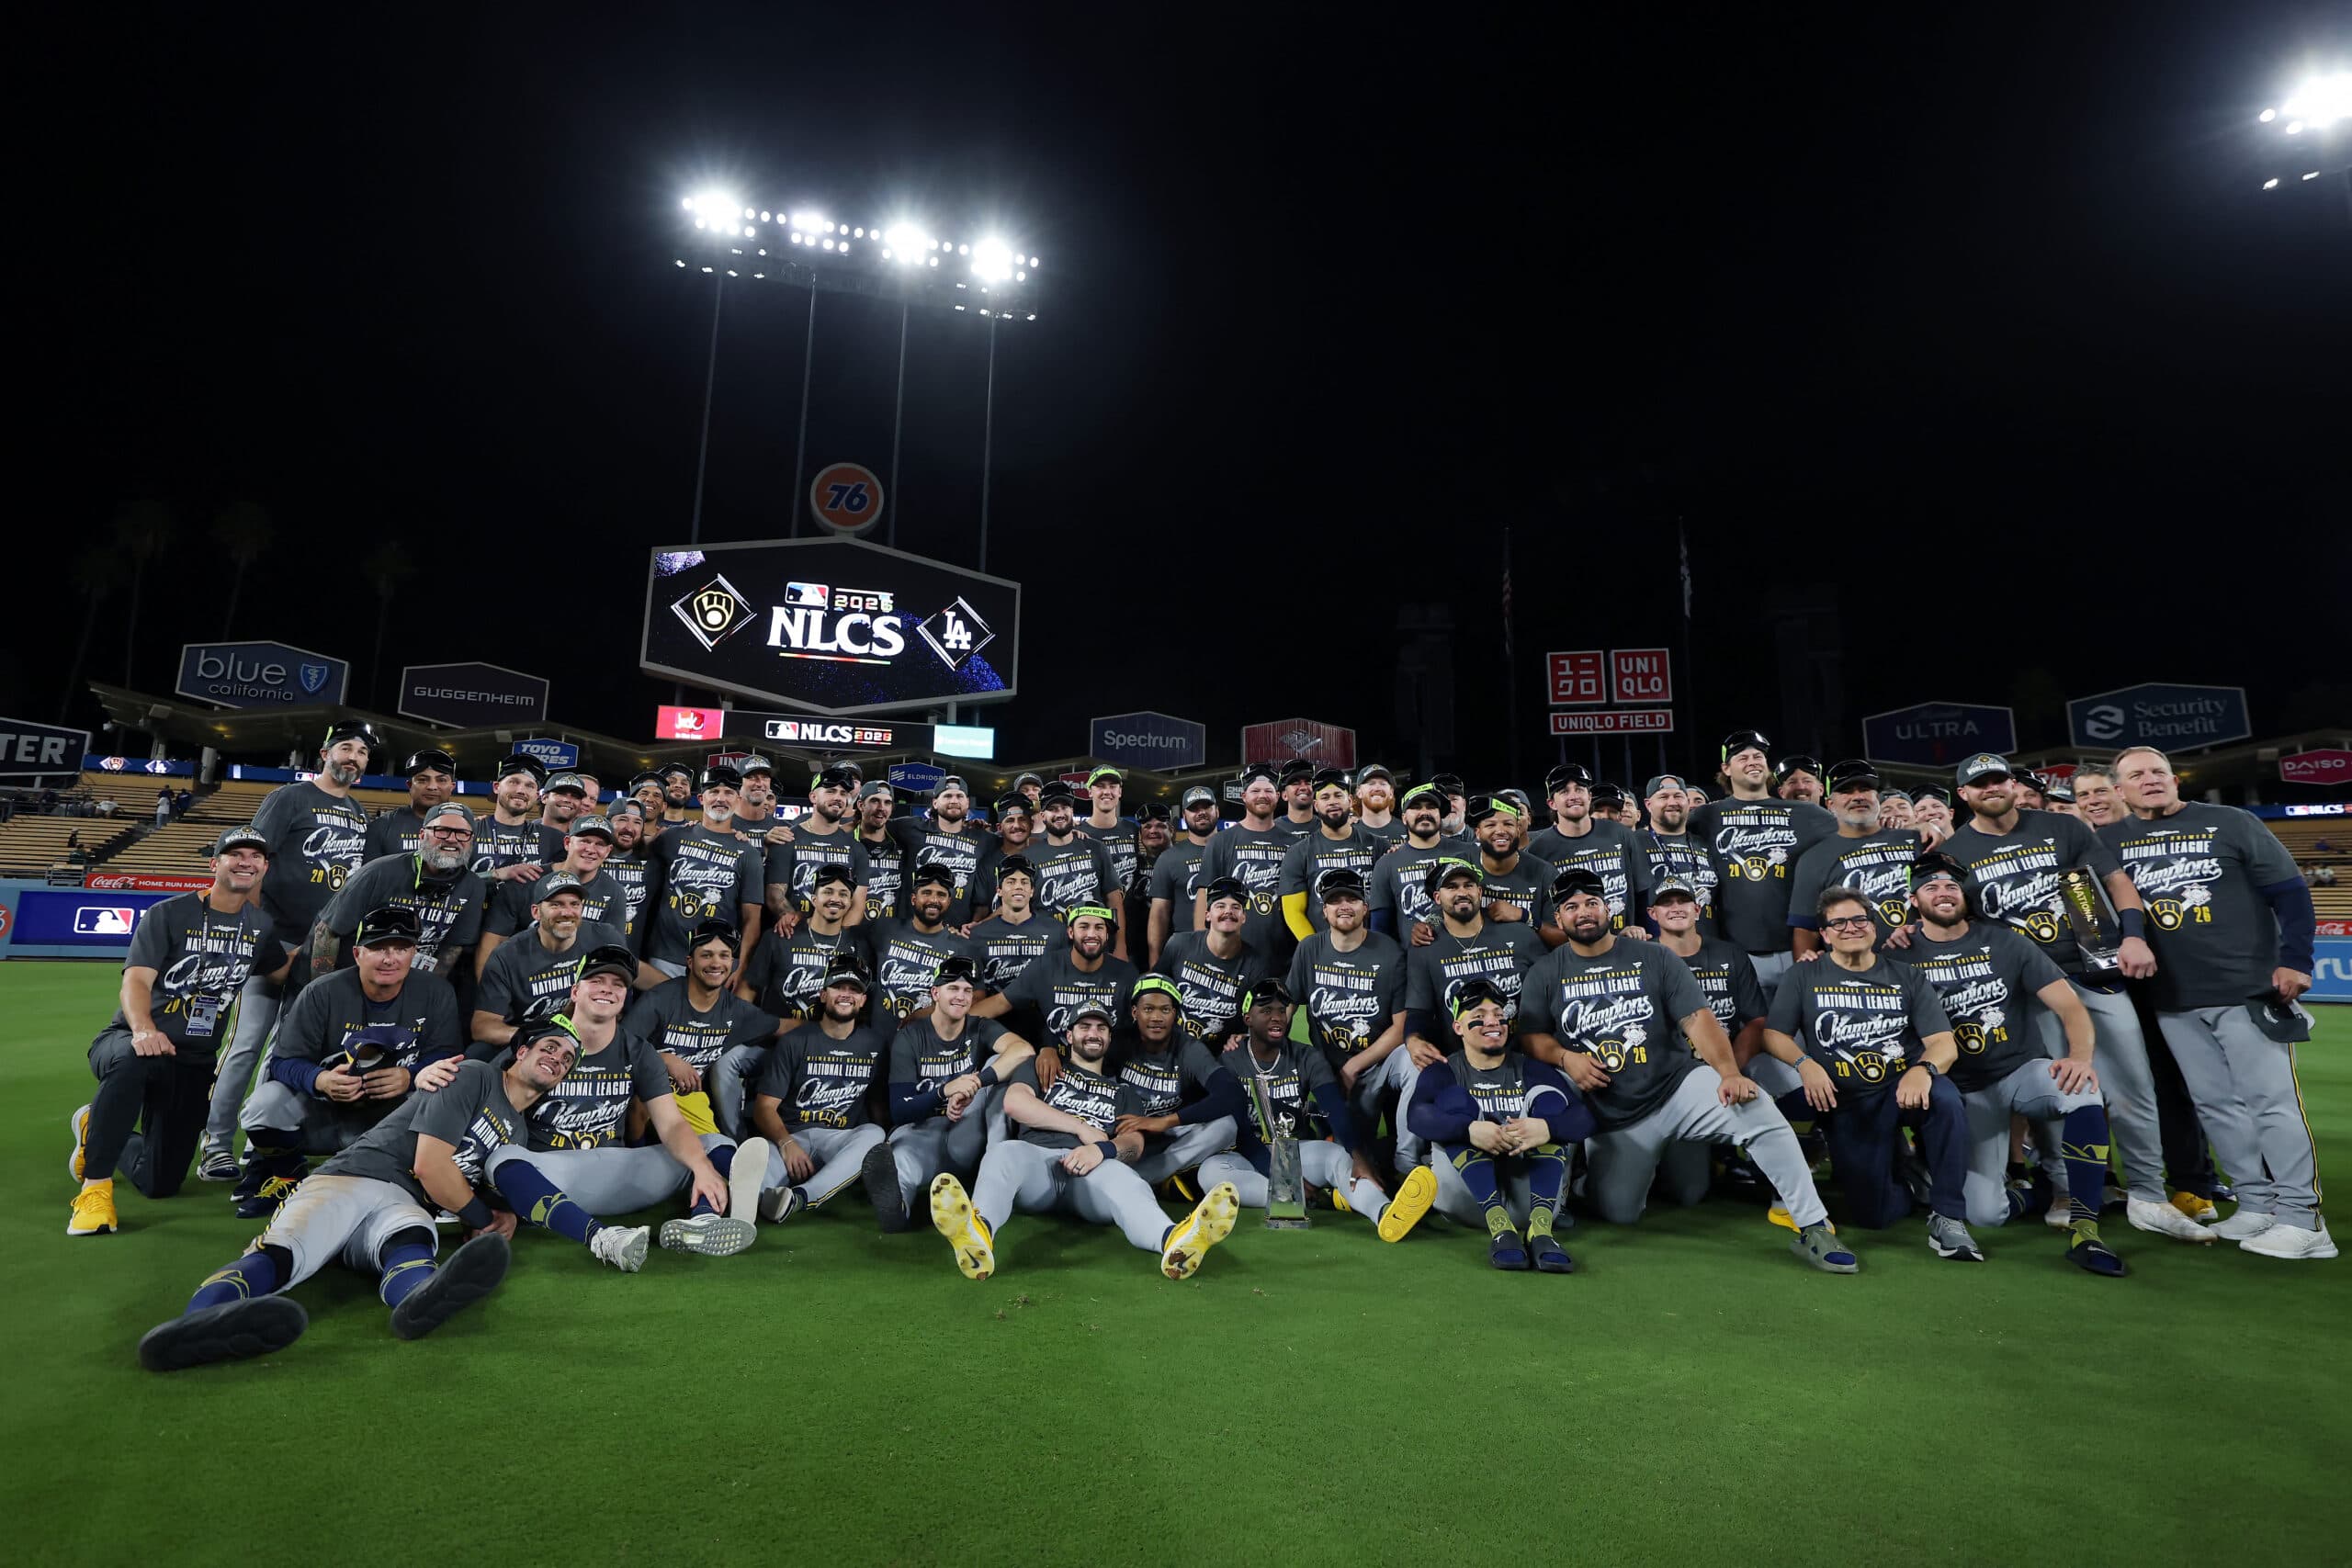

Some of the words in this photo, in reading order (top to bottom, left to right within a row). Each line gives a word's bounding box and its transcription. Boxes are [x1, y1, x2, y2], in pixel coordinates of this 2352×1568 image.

[826, 482, 869, 513] 76
[766, 605, 905, 657] NLCS
[197, 649, 288, 685] blue
[1620, 657, 1657, 673] UNI
[208, 682, 294, 702] california
[1623, 676, 1663, 696] QLO
[414, 686, 534, 706] GUGGENHEIM
[2133, 697, 2227, 718] Security
[1558, 716, 1614, 731] UNIQLO
[1620, 714, 1666, 728] FIELD
[1895, 719, 1980, 740] ULTRA
[2138, 717, 2218, 737] Benefit
[801, 724, 854, 743] NLCS
[1103, 730, 1186, 750] Spectrum
[521, 743, 561, 755] TOYO
[2284, 759, 2346, 770] DAISO
[316, 813, 348, 827] NATIONAL
[1723, 816, 1759, 826] NATIONAL
[1762, 816, 1791, 826] LEAGUE
[925, 835, 955, 849] NATIONAL
[956, 840, 976, 854] LEAGUE
[1117, 844, 1136, 853] LEAGUE
[1715, 827, 1797, 853] Champions
[677, 845, 710, 862] NATIONAL
[711, 852, 737, 867] LEAGUE
[796, 850, 825, 862] NATIONAL
[827, 852, 849, 863] LEAGUE
[1237, 850, 1266, 861] NATIONAL
[2122, 843, 2166, 860] NATIONAL
[2170, 840, 2212, 854] LEAGUE
[880, 859, 899, 870] LEAGUE
[1041, 863, 1069, 878] NATIONAL
[1071, 859, 1093, 871] LEAGUE
[1317, 858, 1348, 868] NATIONAL
[1350, 856, 1373, 867] LEAGUE
[1595, 858, 1622, 871] LEAGUE
[1843, 853, 1883, 870] NATIONAL
[1885, 851, 1915, 862] LEAGUE
[1975, 861, 2020, 883] NATIONAL
[2020, 853, 2058, 872] LEAGUE
[311, 869, 323, 883] 20
[619, 871, 643, 882] LEAGUE
[670, 857, 735, 888] Champions
[1729, 864, 1739, 877] 20
[1041, 873, 1099, 907] Champions
[2193, 906, 2212, 923] 26
[888, 945, 920, 964] NATIONAL
[988, 945, 1020, 956] NATIONAL
[1021, 945, 1046, 955] LEAGUE
[1444, 964, 1484, 978] NATIONAL
[1485, 957, 1515, 973] LEAGUE
[1925, 965, 1957, 983] TIONAL
[1959, 961, 1993, 979] LEAGUE
[532, 976, 571, 996] NATIONAL
[1182, 968, 1212, 988] NATIONAL
[1213, 979, 1238, 998] LEAGUE
[1316, 972, 1346, 987] NATIONAL
[1347, 976, 1374, 991] LEAGUE
[1564, 982, 1606, 999] NATIONAL
[1608, 976, 1641, 993] LEAGUE
[1310, 987, 1379, 1021] Champions
[1817, 994, 1863, 1010] NATIONAL
[1866, 996, 1903, 1010] LEAGUE
[1562, 996, 1654, 1039] Champions
[664, 1031, 698, 1047] NATIONAL
[1634, 1046, 1647, 1065] 26
[807, 1063, 842, 1076] NATIONAL
[845, 1063, 872, 1077] LEAGUE
[921, 1063, 952, 1077] NATIONAL
[1835, 1061, 1850, 1077] 20
[597, 1080, 632, 1096] LEAGUE
[1089, 1085, 1119, 1100] LEAGUE
[1272, 1083, 1299, 1099] LEAGUE
[1496, 1097, 1524, 1112] LEAGUE
